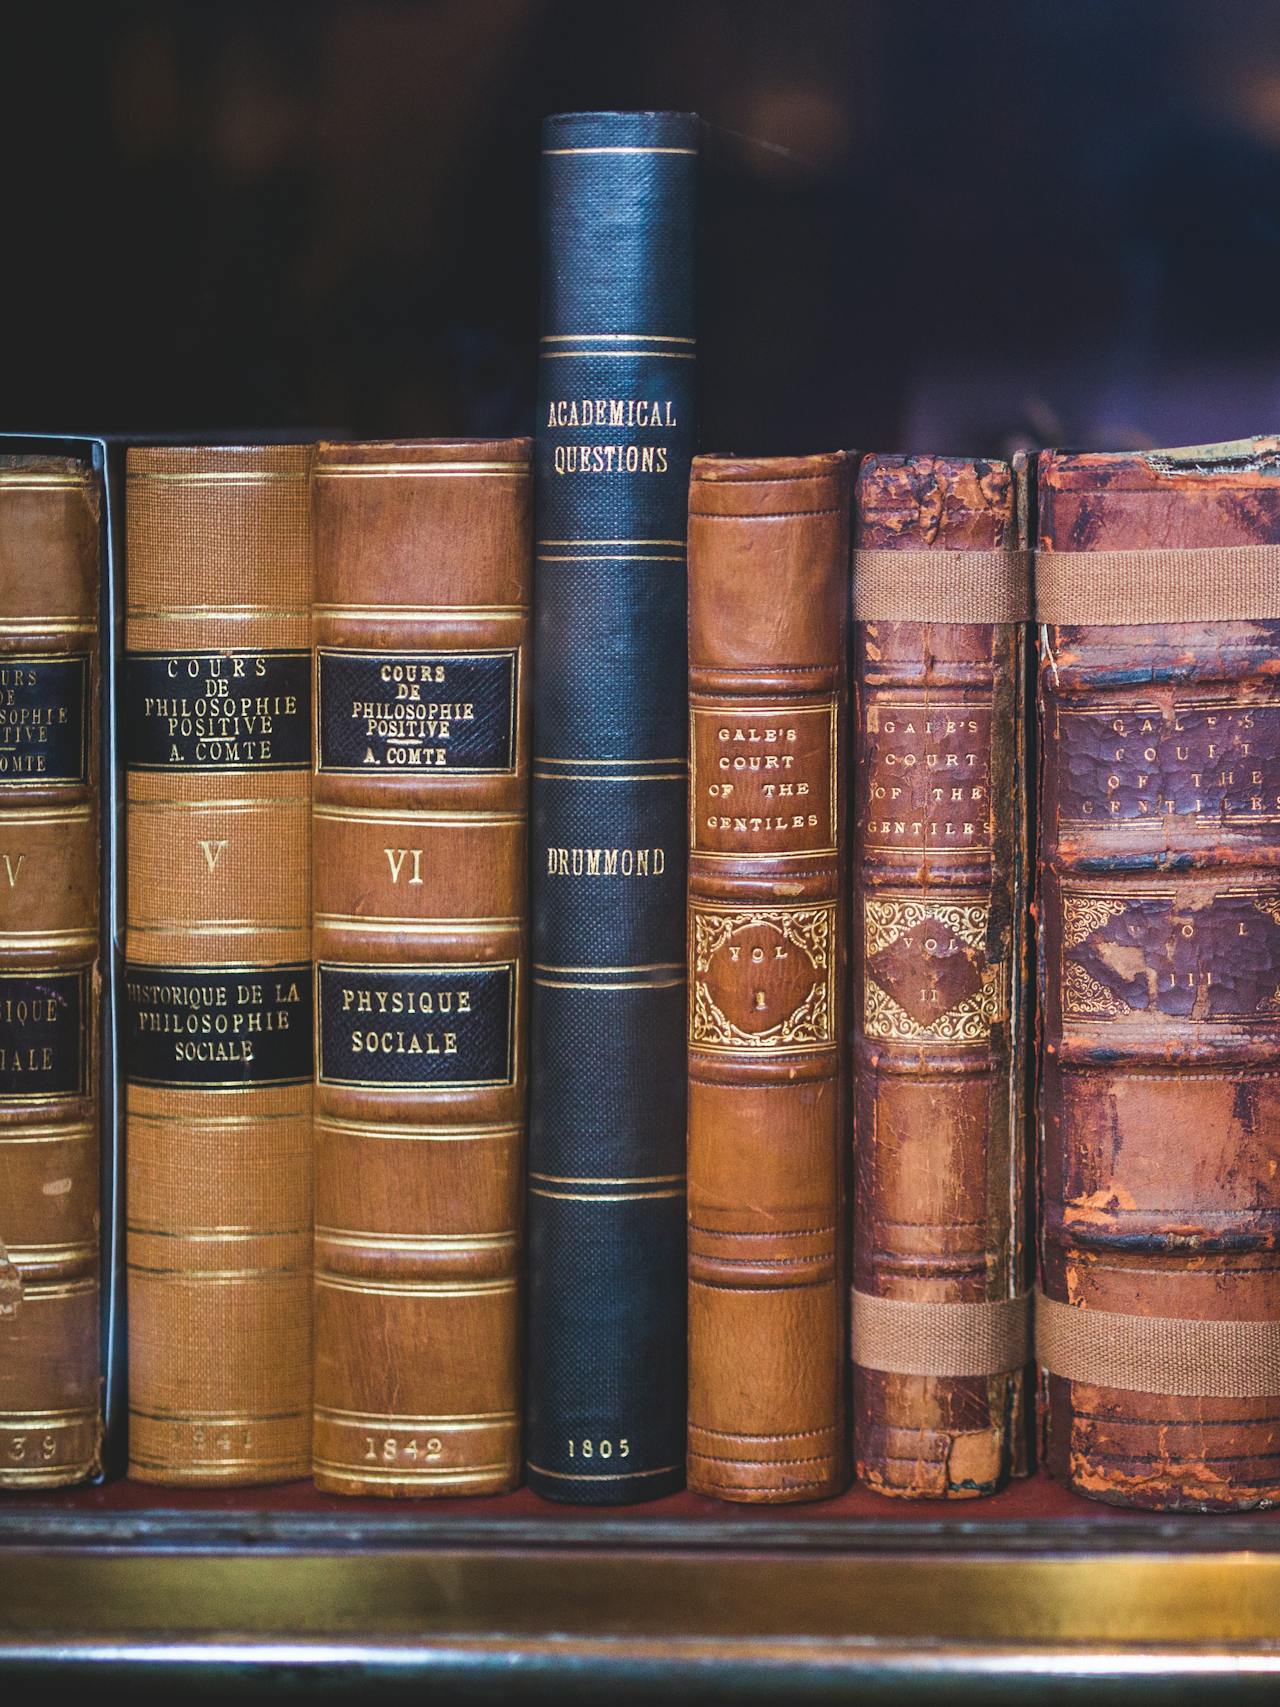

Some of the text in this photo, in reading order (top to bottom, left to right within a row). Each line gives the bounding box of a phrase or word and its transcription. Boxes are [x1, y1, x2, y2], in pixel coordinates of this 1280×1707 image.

[547, 399, 677, 428] ACADEMICAL
[554, 445, 668, 475] QUESTIONS
[167, 658, 267, 678] COURS
[380, 665, 446, 682] COURS
[205, 678, 229, 698] DE
[395, 683, 421, 701] DE
[144, 696, 297, 717] PHILOSOPHIE
[352, 702, 474, 720] PHILOSOPHIE
[168, 716, 273, 737] POSITIVE
[366, 719, 451, 738] POSITIVE
[1112, 715, 1255, 732] GALE'S
[4, 726, 48, 743] TIVE
[718, 728, 797, 743] GALE'S
[169, 741, 272, 762] A. COMTE
[363, 747, 447, 766] A. COMTE
[885, 753, 978, 767] COURT
[719, 755, 795, 770] COURT
[708, 782, 810, 797] OF THE
[1107, 771, 1264, 790] OF THE
[875, 787, 982, 801] OF THE
[707, 815, 818, 833] GENTILES
[868, 821, 991, 836] GENTILES
[200, 841, 229, 873] V
[384, 848, 424, 884] VI
[547, 847, 666, 878] DRUMMOND
[3, 855, 25, 887] V
[902, 937, 959, 952] VOL
[728, 945, 789, 964] VOL
[1169, 972, 1213, 988] III
[127, 983, 300, 1010] HISTORIQUE DE LA
[342, 988, 472, 1014] PHYSIQUE
[919, 988, 939, 1003] II
[0, 999, 57, 1026] IQUE
[139, 1010, 290, 1034] PHILOSOPHIE
[175, 1039, 255, 1062] SOCIALE
[352, 1031, 458, 1055] SOCIALE
[364, 1437, 443, 1461] 1842
[567, 1438, 631, 1459] 1805
